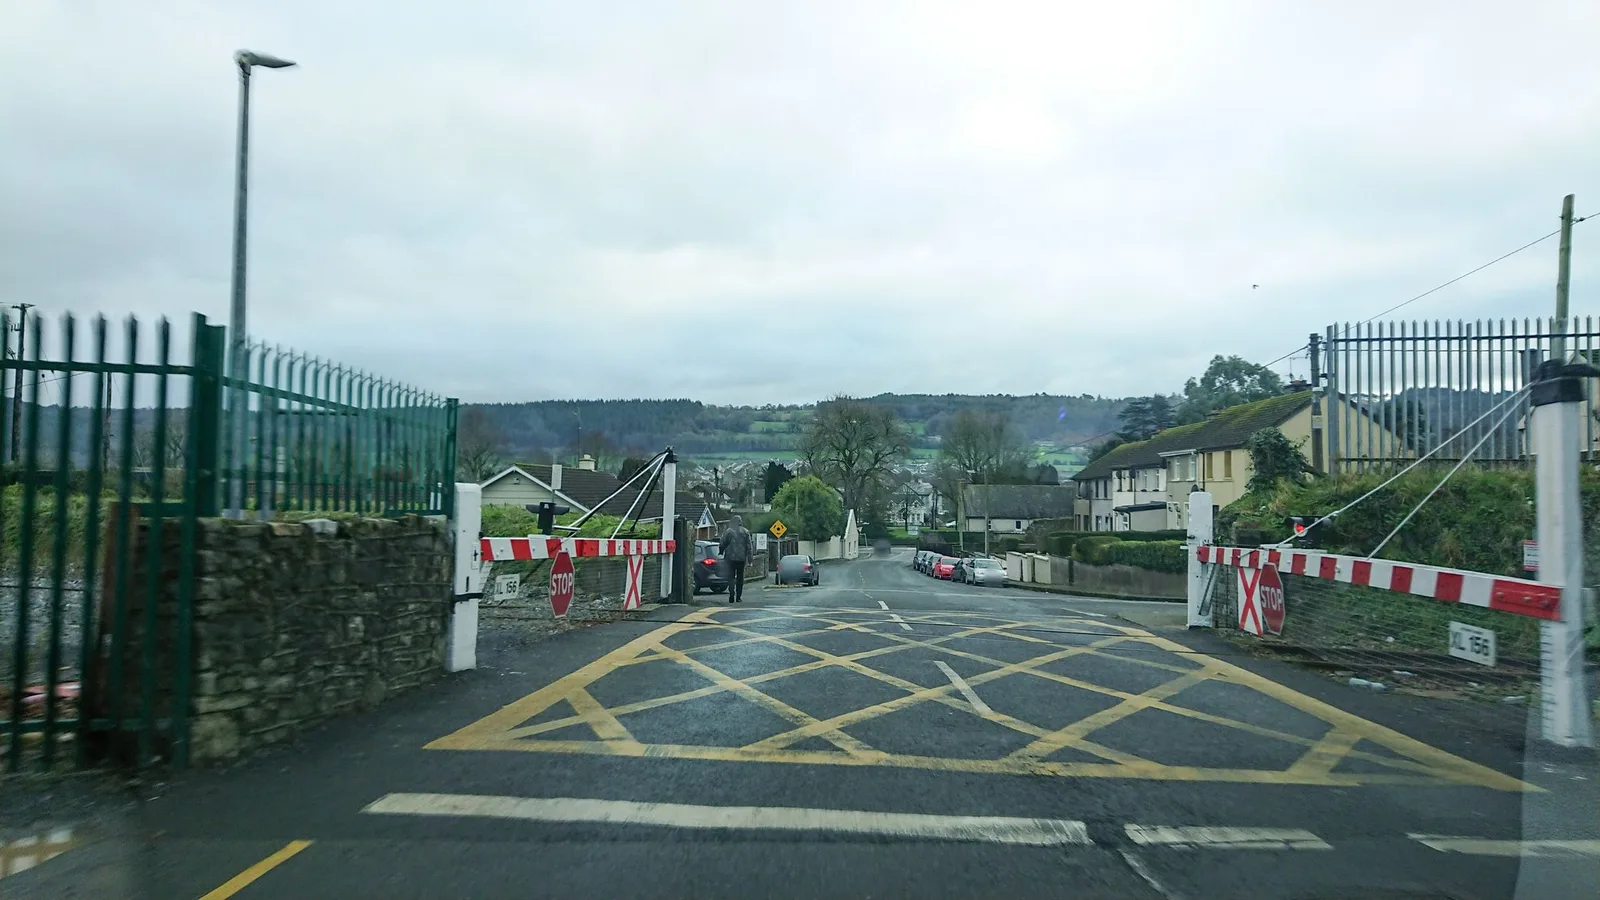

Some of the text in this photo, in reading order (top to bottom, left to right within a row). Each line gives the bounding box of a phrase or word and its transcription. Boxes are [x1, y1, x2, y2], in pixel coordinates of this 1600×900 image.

[506, 581, 517, 593] 156
[551, 573, 573, 596] STOP
[1260, 585, 1283, 611] STOP
[1469, 635, 1489, 656] 156
